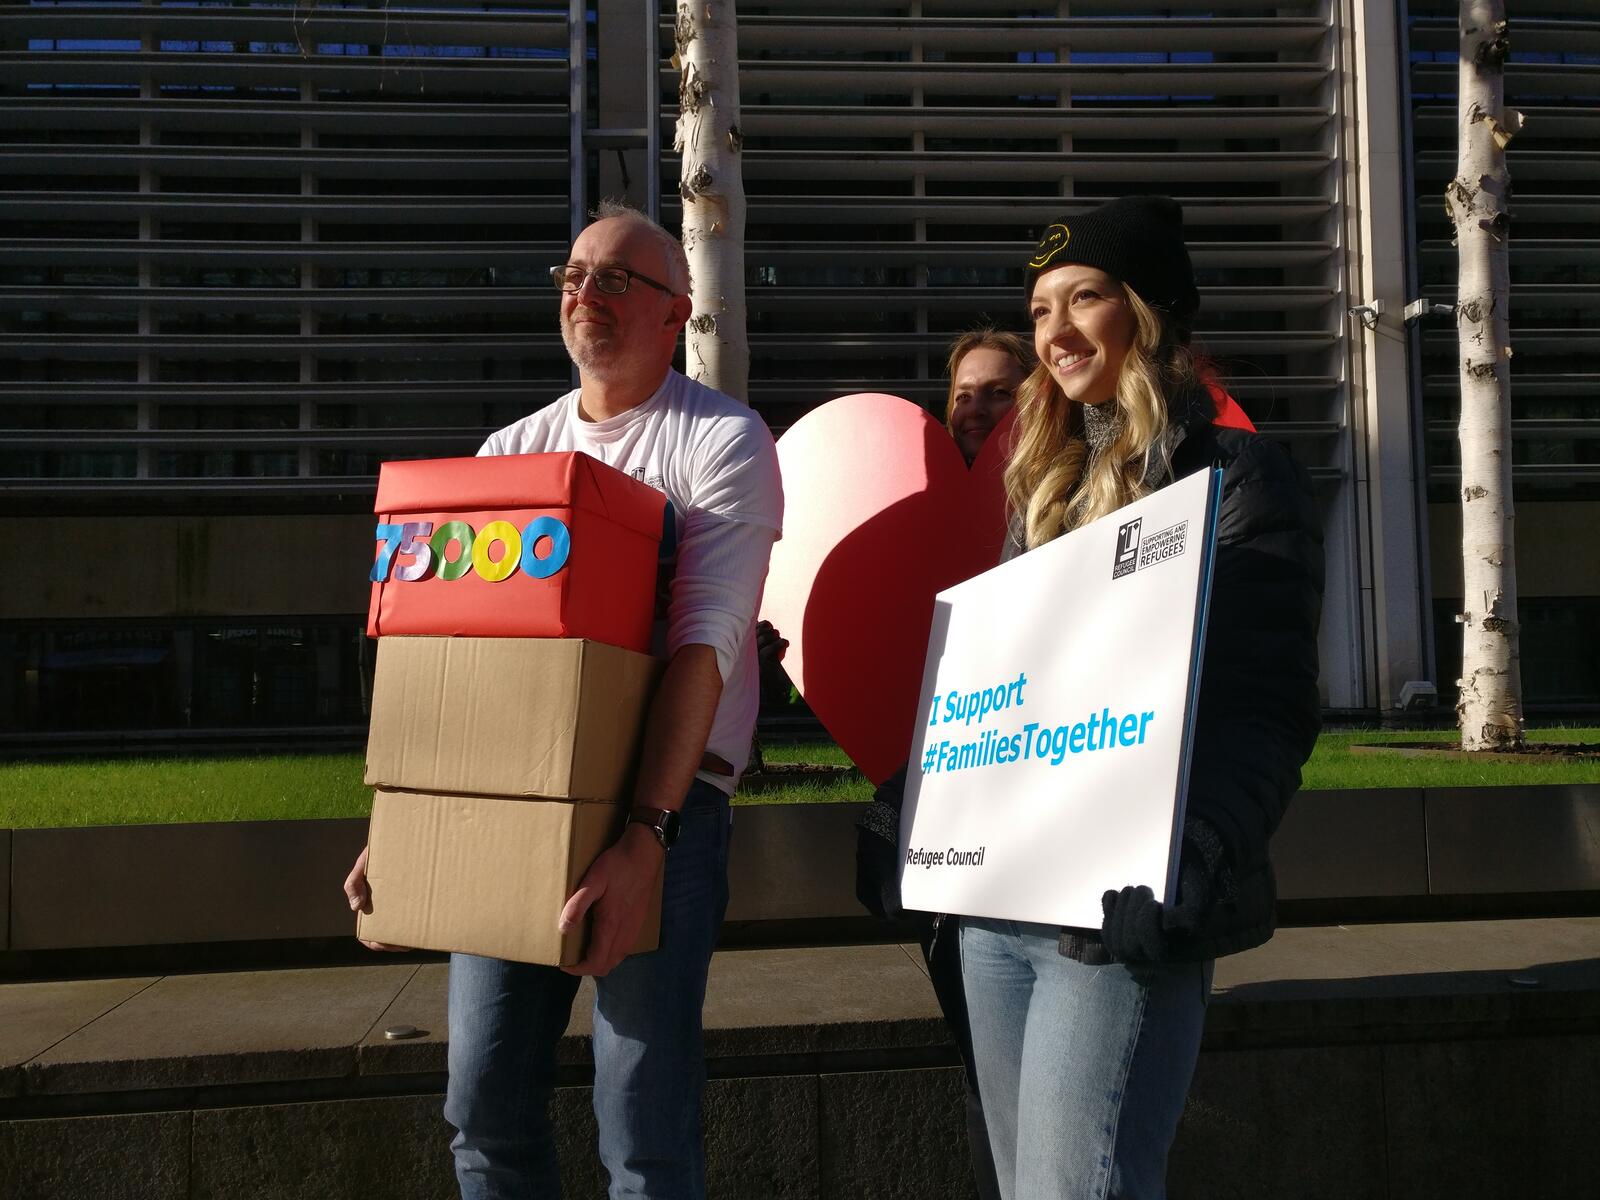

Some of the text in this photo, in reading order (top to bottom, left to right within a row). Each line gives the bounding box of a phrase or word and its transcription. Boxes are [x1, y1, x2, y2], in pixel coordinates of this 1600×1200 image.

[1141, 531, 1186, 555] EMPOWERING
[1142, 523, 1186, 547] SUPPORTING AND
[370, 516, 571, 583] 75000
[1140, 540, 1184, 567] REFUGEES
[1113, 566, 1136, 578] COUNCIL
[1115, 558, 1136, 572] REFUGEE
[929, 672, 1027, 726] I Support
[922, 708, 1154, 774] #FamiliesTogether
[906, 846, 985, 869] Refugee Council
